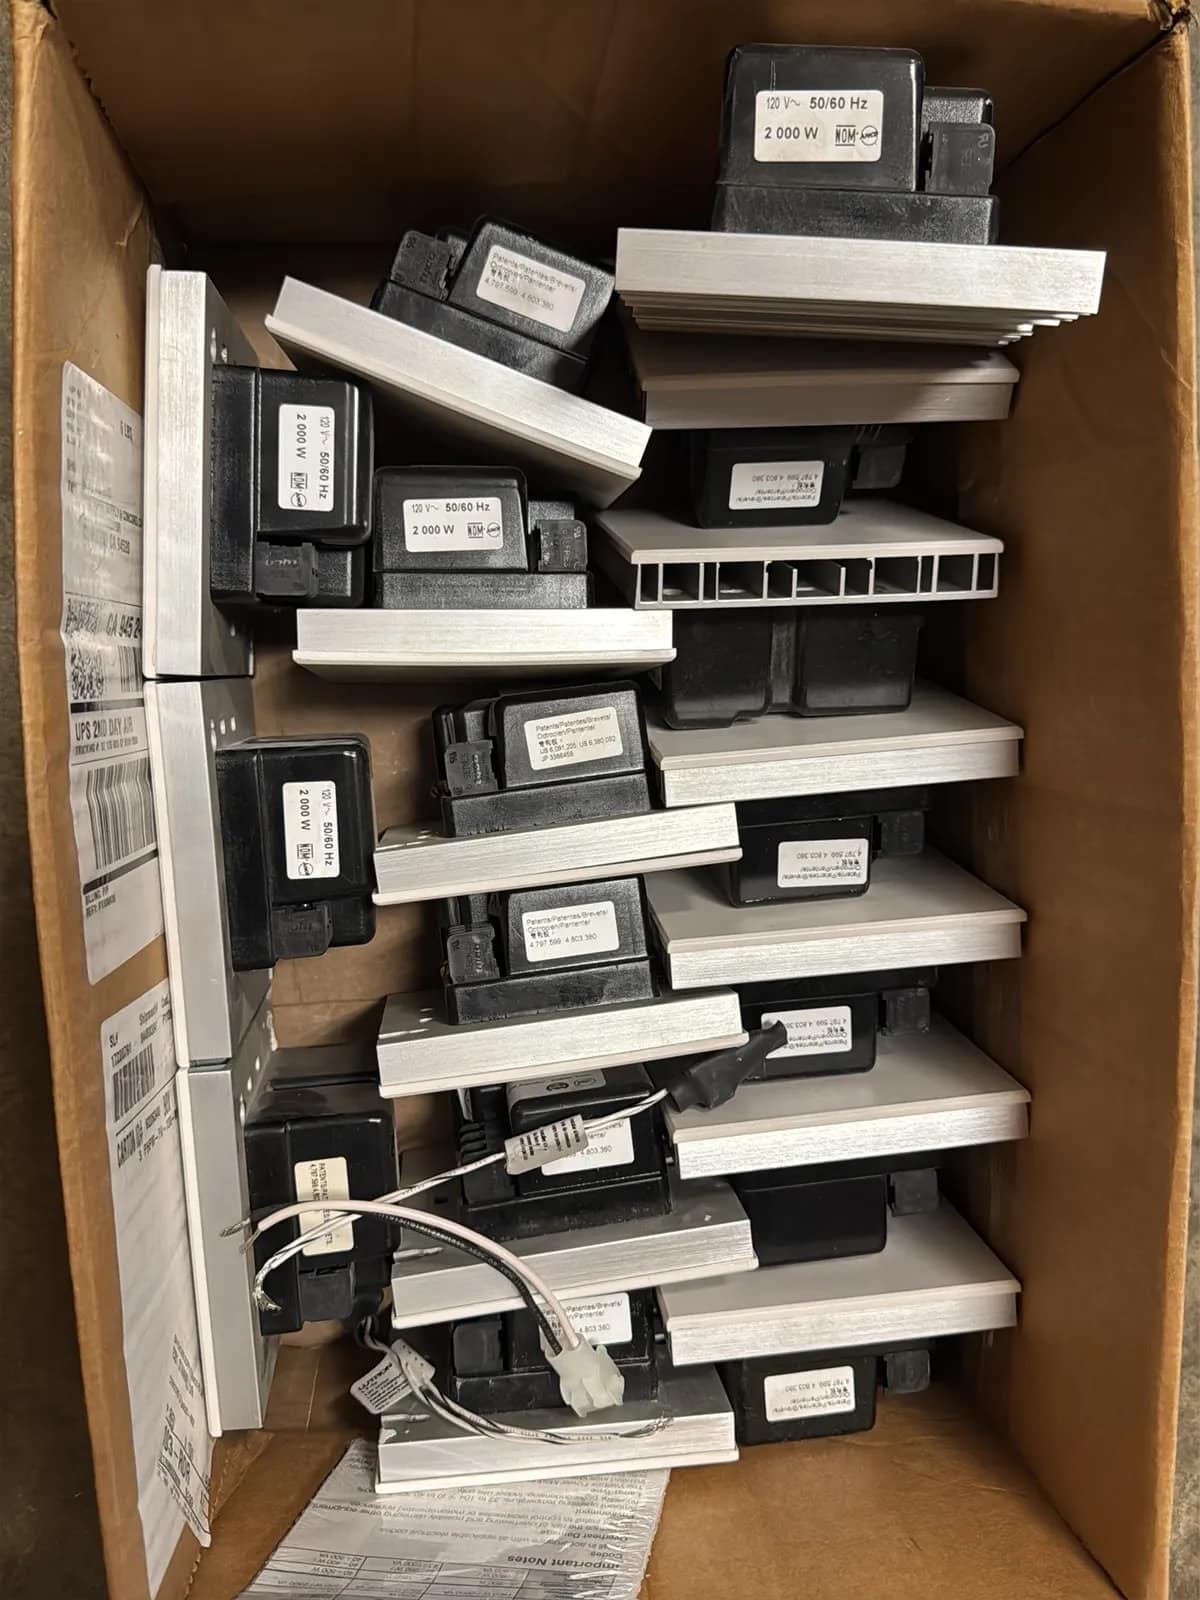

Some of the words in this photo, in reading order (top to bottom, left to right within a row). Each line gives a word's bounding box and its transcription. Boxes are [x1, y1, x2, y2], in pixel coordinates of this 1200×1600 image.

[767, 97, 780, 110] 120
[810, 97, 845, 110] 50/60
[850, 98, 868, 110] Hz
[776, 127, 800, 139] 000
[805, 127, 818, 139] W
[320, 416, 330, 428] 120
[297, 424, 306, 444] 000
[296, 448, 306, 459] W
[320, 452, 330, 481] 50/60
[320, 485, 328, 500] Hz
[412, 504, 424, 513] 120
[446, 503, 472, 512] 50/60
[476, 502, 490, 512] Hz
[422, 526, 440, 534] 000
[444, 525, 454, 534] W
[76, 720, 90, 740] UPS
[94, 719, 108, 738] 2ND
[109, 718, 122, 738] DAY
[322, 789, 332, 800] 120
[300, 798, 310, 816] 000
[301, 820, 310, 830] W
[324, 822, 334, 849] 50/60
[324, 852, 334, 866] Hz
[507, 1556, 547, 1566] Notes
[551, 1559, 621, 1570] mportant
